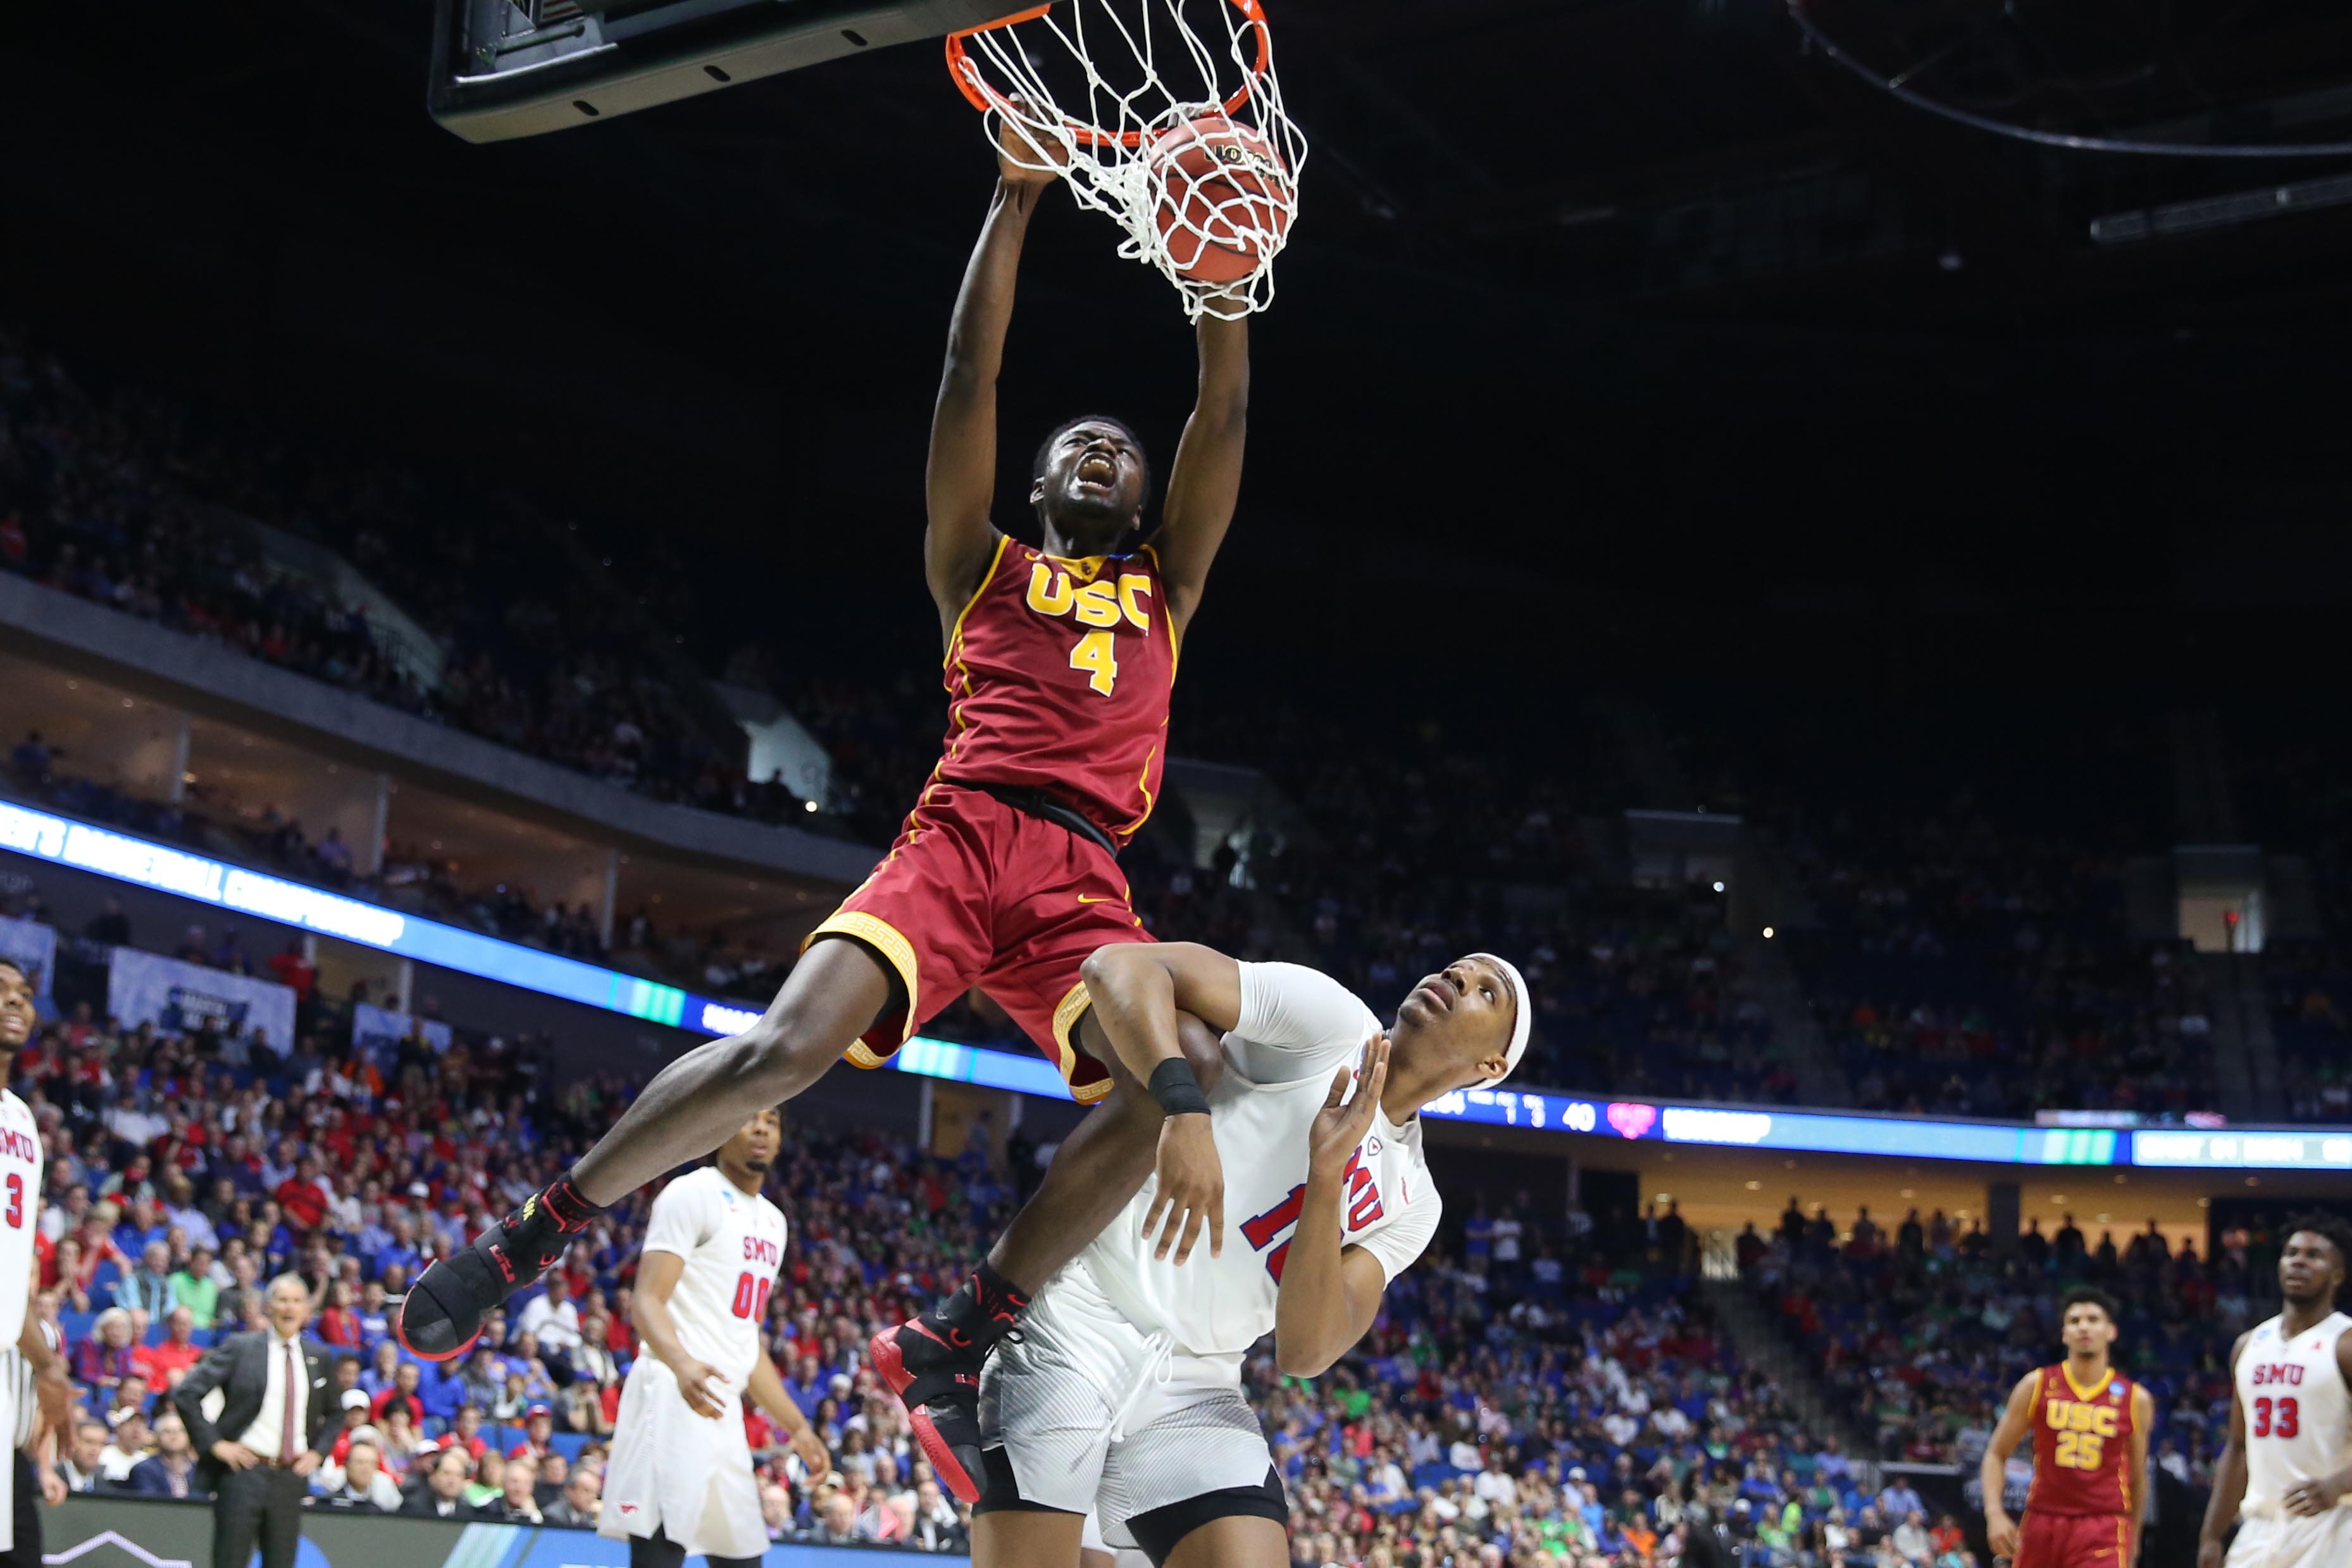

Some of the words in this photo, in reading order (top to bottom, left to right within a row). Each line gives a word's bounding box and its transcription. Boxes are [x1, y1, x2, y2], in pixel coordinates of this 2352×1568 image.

[1026, 563, 1152, 636] USC
[1069, 629, 1117, 697] 4
[1562, 1102, 1596, 1132] 40
[6, 1173, 23, 1229] 3
[743, 1235, 778, 1267] SMU
[2253, 1363, 2304, 1385] SMU
[2046, 1398, 2119, 1438] USC
[2254, 1397, 2298, 1438] 33
[2055, 1429, 2105, 1472] 25
